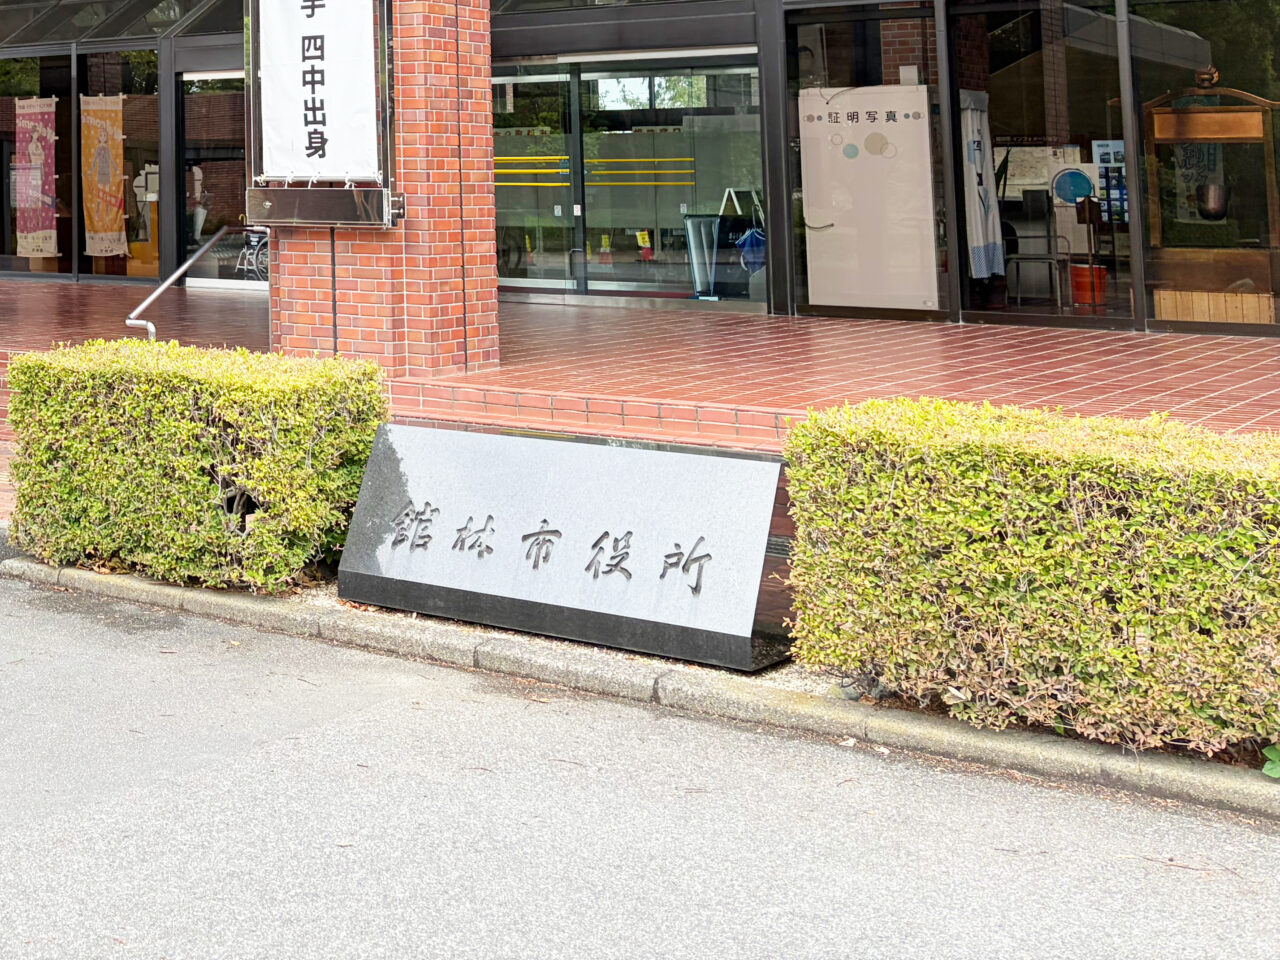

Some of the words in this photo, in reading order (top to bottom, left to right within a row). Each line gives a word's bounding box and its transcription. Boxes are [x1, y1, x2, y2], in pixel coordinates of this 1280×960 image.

[300, 33, 330, 160] 四中出身
[827, 110, 898, 124] 証明写真
[389, 499, 714, 598] 館林市役所
